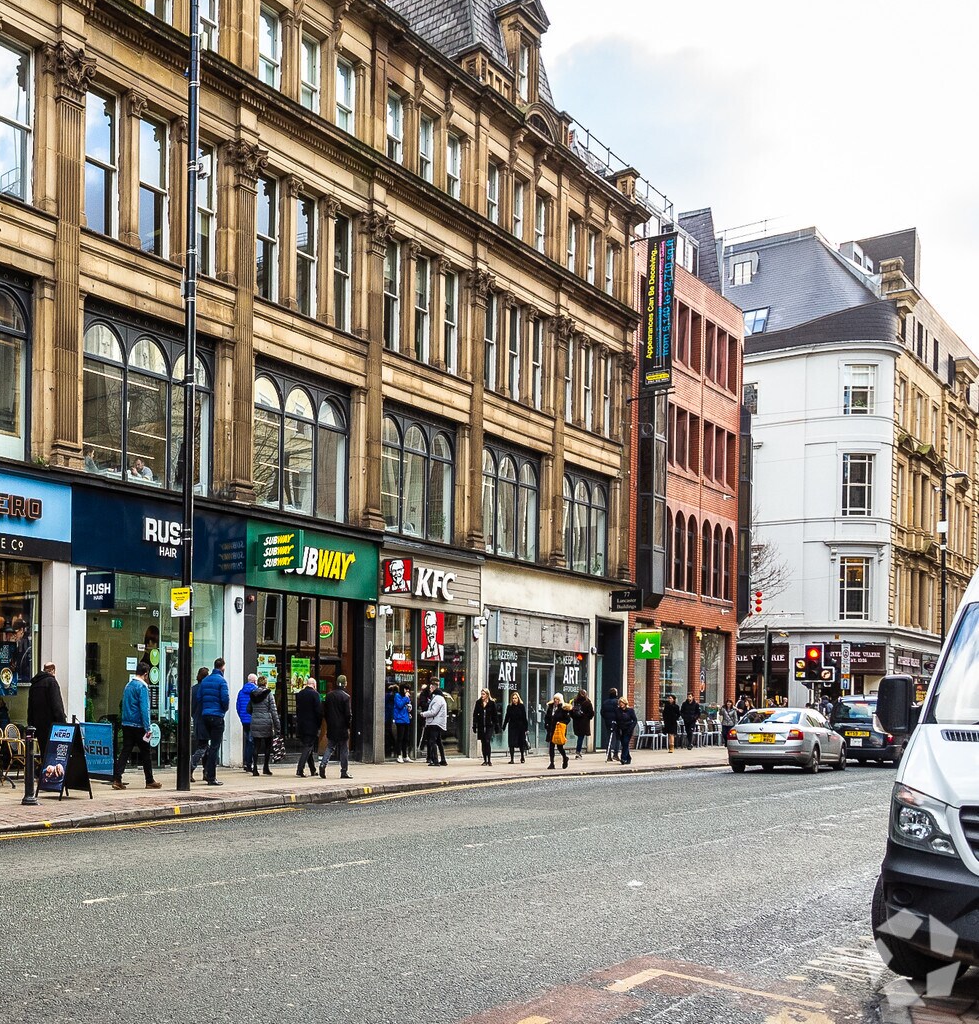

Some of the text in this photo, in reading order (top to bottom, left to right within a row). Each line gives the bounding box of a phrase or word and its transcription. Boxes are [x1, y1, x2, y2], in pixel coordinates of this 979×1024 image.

[143, 516, 184, 546] RUS
[263, 533, 295, 546] SUBWAY
[159, 546, 177, 559] HAIR
[263, 544, 295, 557] SUBWAY
[263, 555, 295, 568] SUBWAY
[284, 546, 356, 581] UBWAY
[86, 582, 111, 595] RUSH
[413, 567, 456, 601] KFC
[498, 662, 518, 682] ART
[563, 666, 580, 684] ART
